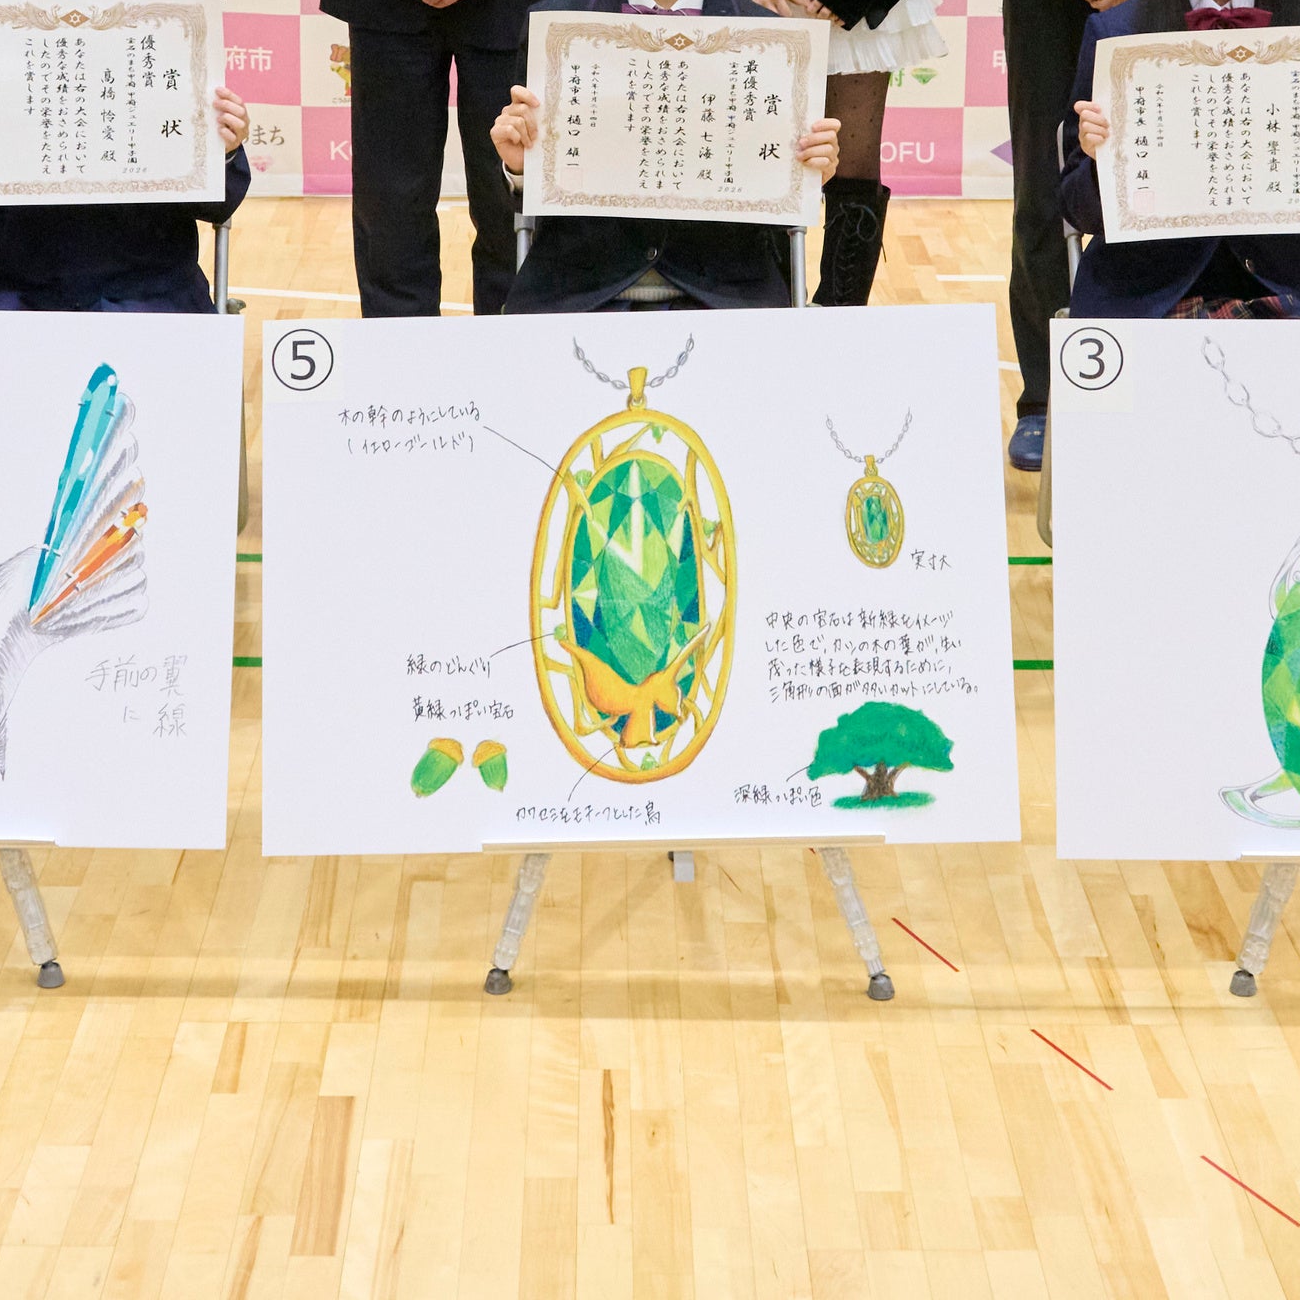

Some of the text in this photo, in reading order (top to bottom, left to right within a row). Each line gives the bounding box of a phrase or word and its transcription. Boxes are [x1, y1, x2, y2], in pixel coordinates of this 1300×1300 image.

[141, 35, 156, 88] 優秀賞
[225, 46, 273, 71] 府市
[569, 65, 580, 105] 甲府市長
[743, 61, 758, 122] 最優秀賞
[701, 94, 716, 123] 伊藤
[1134, 86, 1146, 126] 甲府市長
[1266, 104, 1281, 132] 小林
[699, 132, 713, 160] 七海
[880, 141, 935, 164] OFU
[910, 549, 952, 571] 実寸大
[406, 654, 491, 679] 緑のどんぐり
